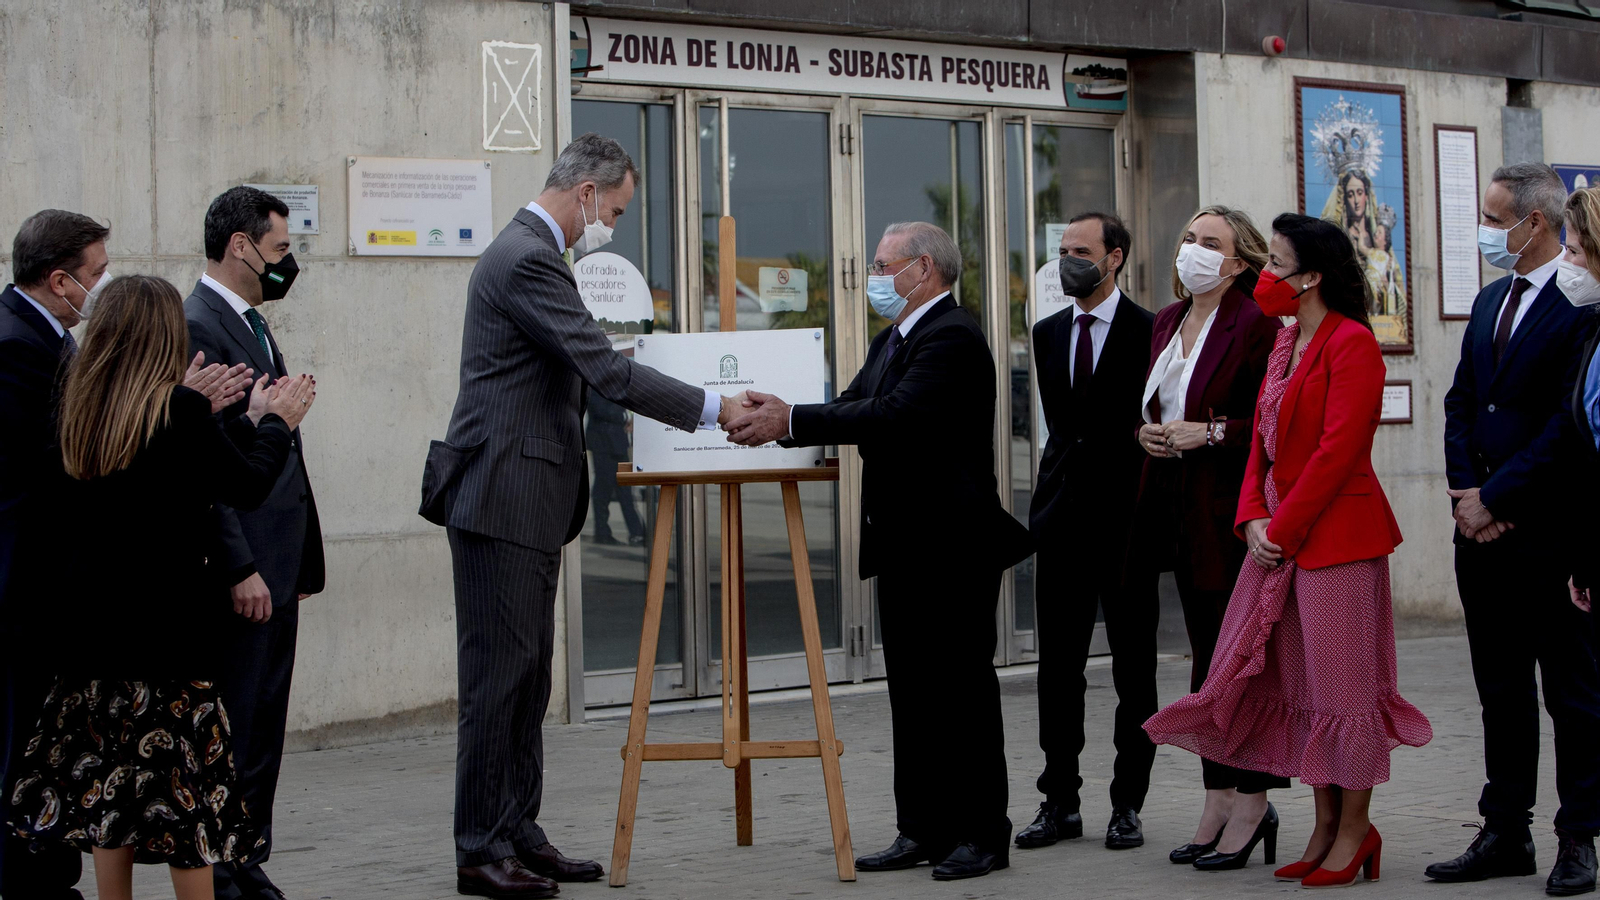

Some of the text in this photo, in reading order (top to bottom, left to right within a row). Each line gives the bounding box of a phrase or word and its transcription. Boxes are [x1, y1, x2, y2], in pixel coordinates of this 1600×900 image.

[608, 33, 677, 65] ZONA
[687, 38, 717, 68] DE
[727, 41, 800, 73] LONJA
[828, 48, 933, 82] SUBASTA
[941, 56, 1051, 92] PESQUERA
[434, 173, 441, 181] de
[449, 174, 477, 182] operaciones
[397, 182, 416, 191] primera
[443, 184, 455, 192] lonja
[455, 184, 476, 192] pesquera
[362, 190, 369, 198] de
[369, 190, 390, 199] Bonanza
[414, 191, 420, 199] de
[581, 264, 617, 276] Cofradía
[581, 279, 626, 291] pescadores
[590, 291, 626, 302] Sanlúcar
